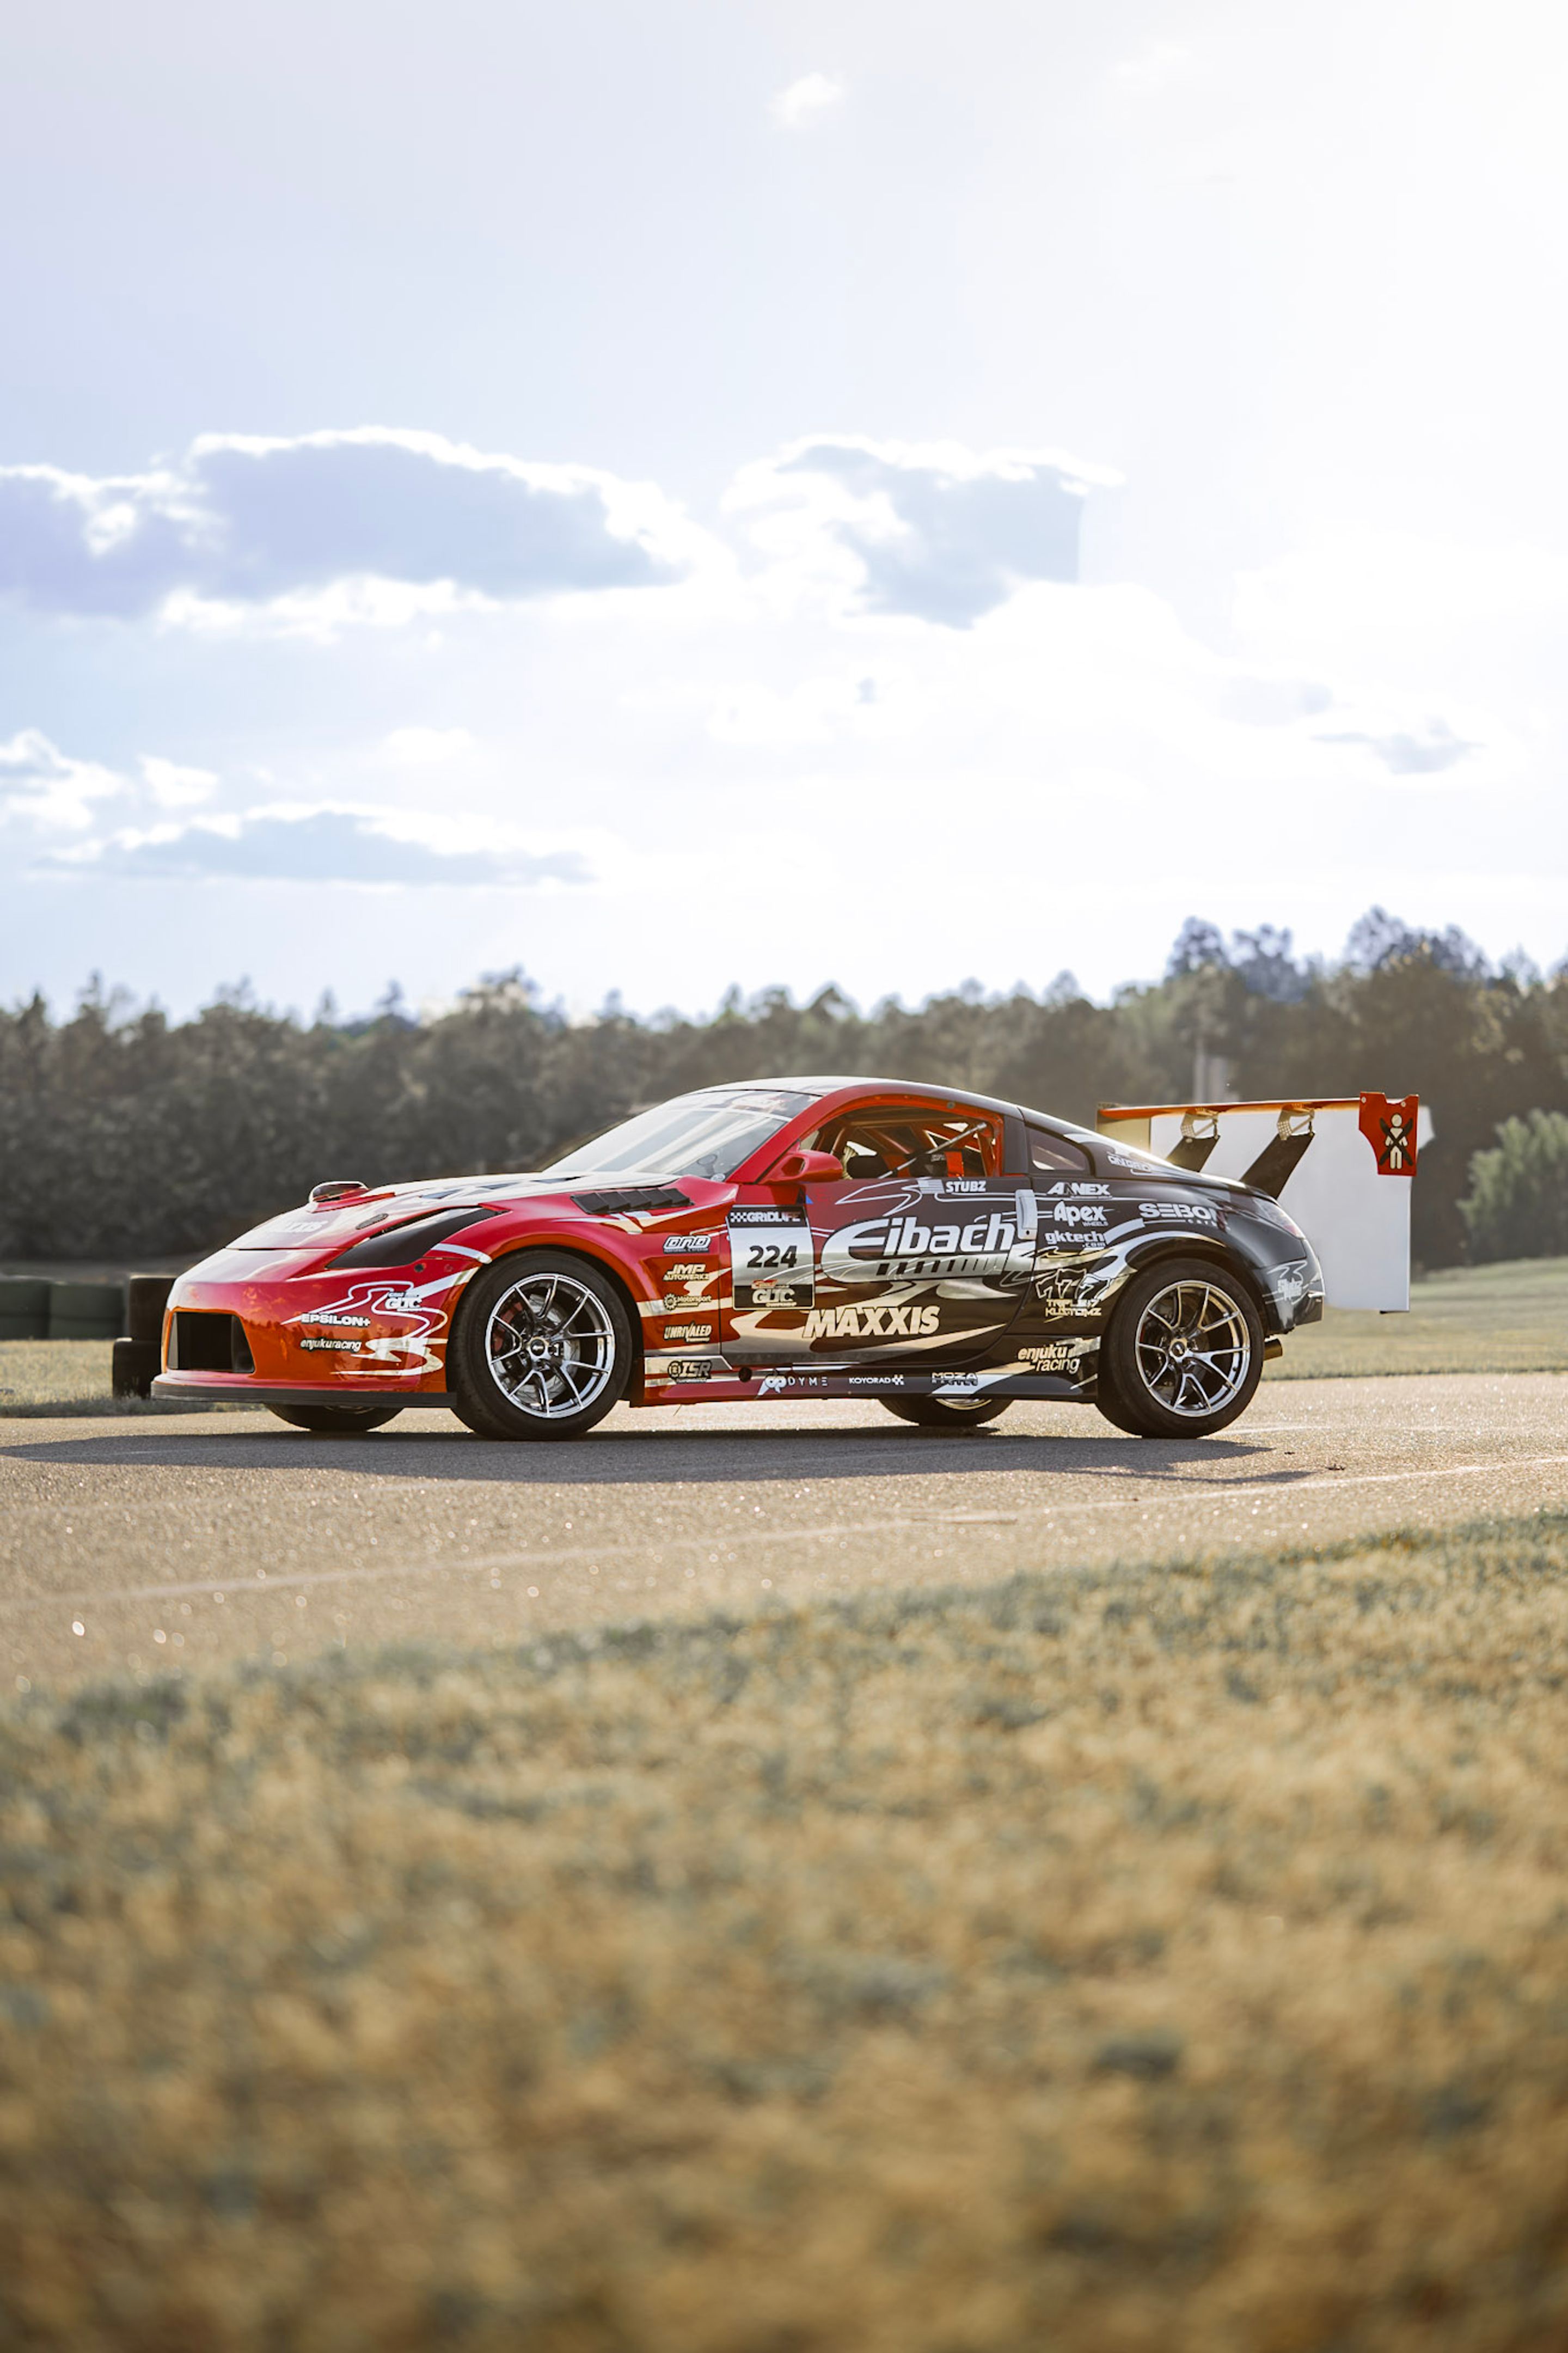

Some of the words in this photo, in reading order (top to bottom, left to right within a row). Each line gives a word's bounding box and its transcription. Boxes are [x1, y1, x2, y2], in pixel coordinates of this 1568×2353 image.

[945, 1181, 987, 1193] STUBZ
[746, 1212, 801, 1222] GRIDLIFE
[1054, 1201, 1107, 1226] Apex
[1045, 1230, 1105, 1244] gktech
[820, 1213, 1016, 1283] Eibach
[746, 1245, 798, 1268] 224
[666, 1264, 706, 1275] JMP
[802, 1306, 941, 1338] MAXXIS
[664, 1322, 712, 1341] UNRIVALED
[301, 1339, 362, 1352] enjukuracing
[1018, 1344, 1068, 1362] enjuku
[679, 1361, 711, 1378] ISR
[1036, 1358, 1080, 1374] racing
[787, 1376, 828, 1386] DYME
